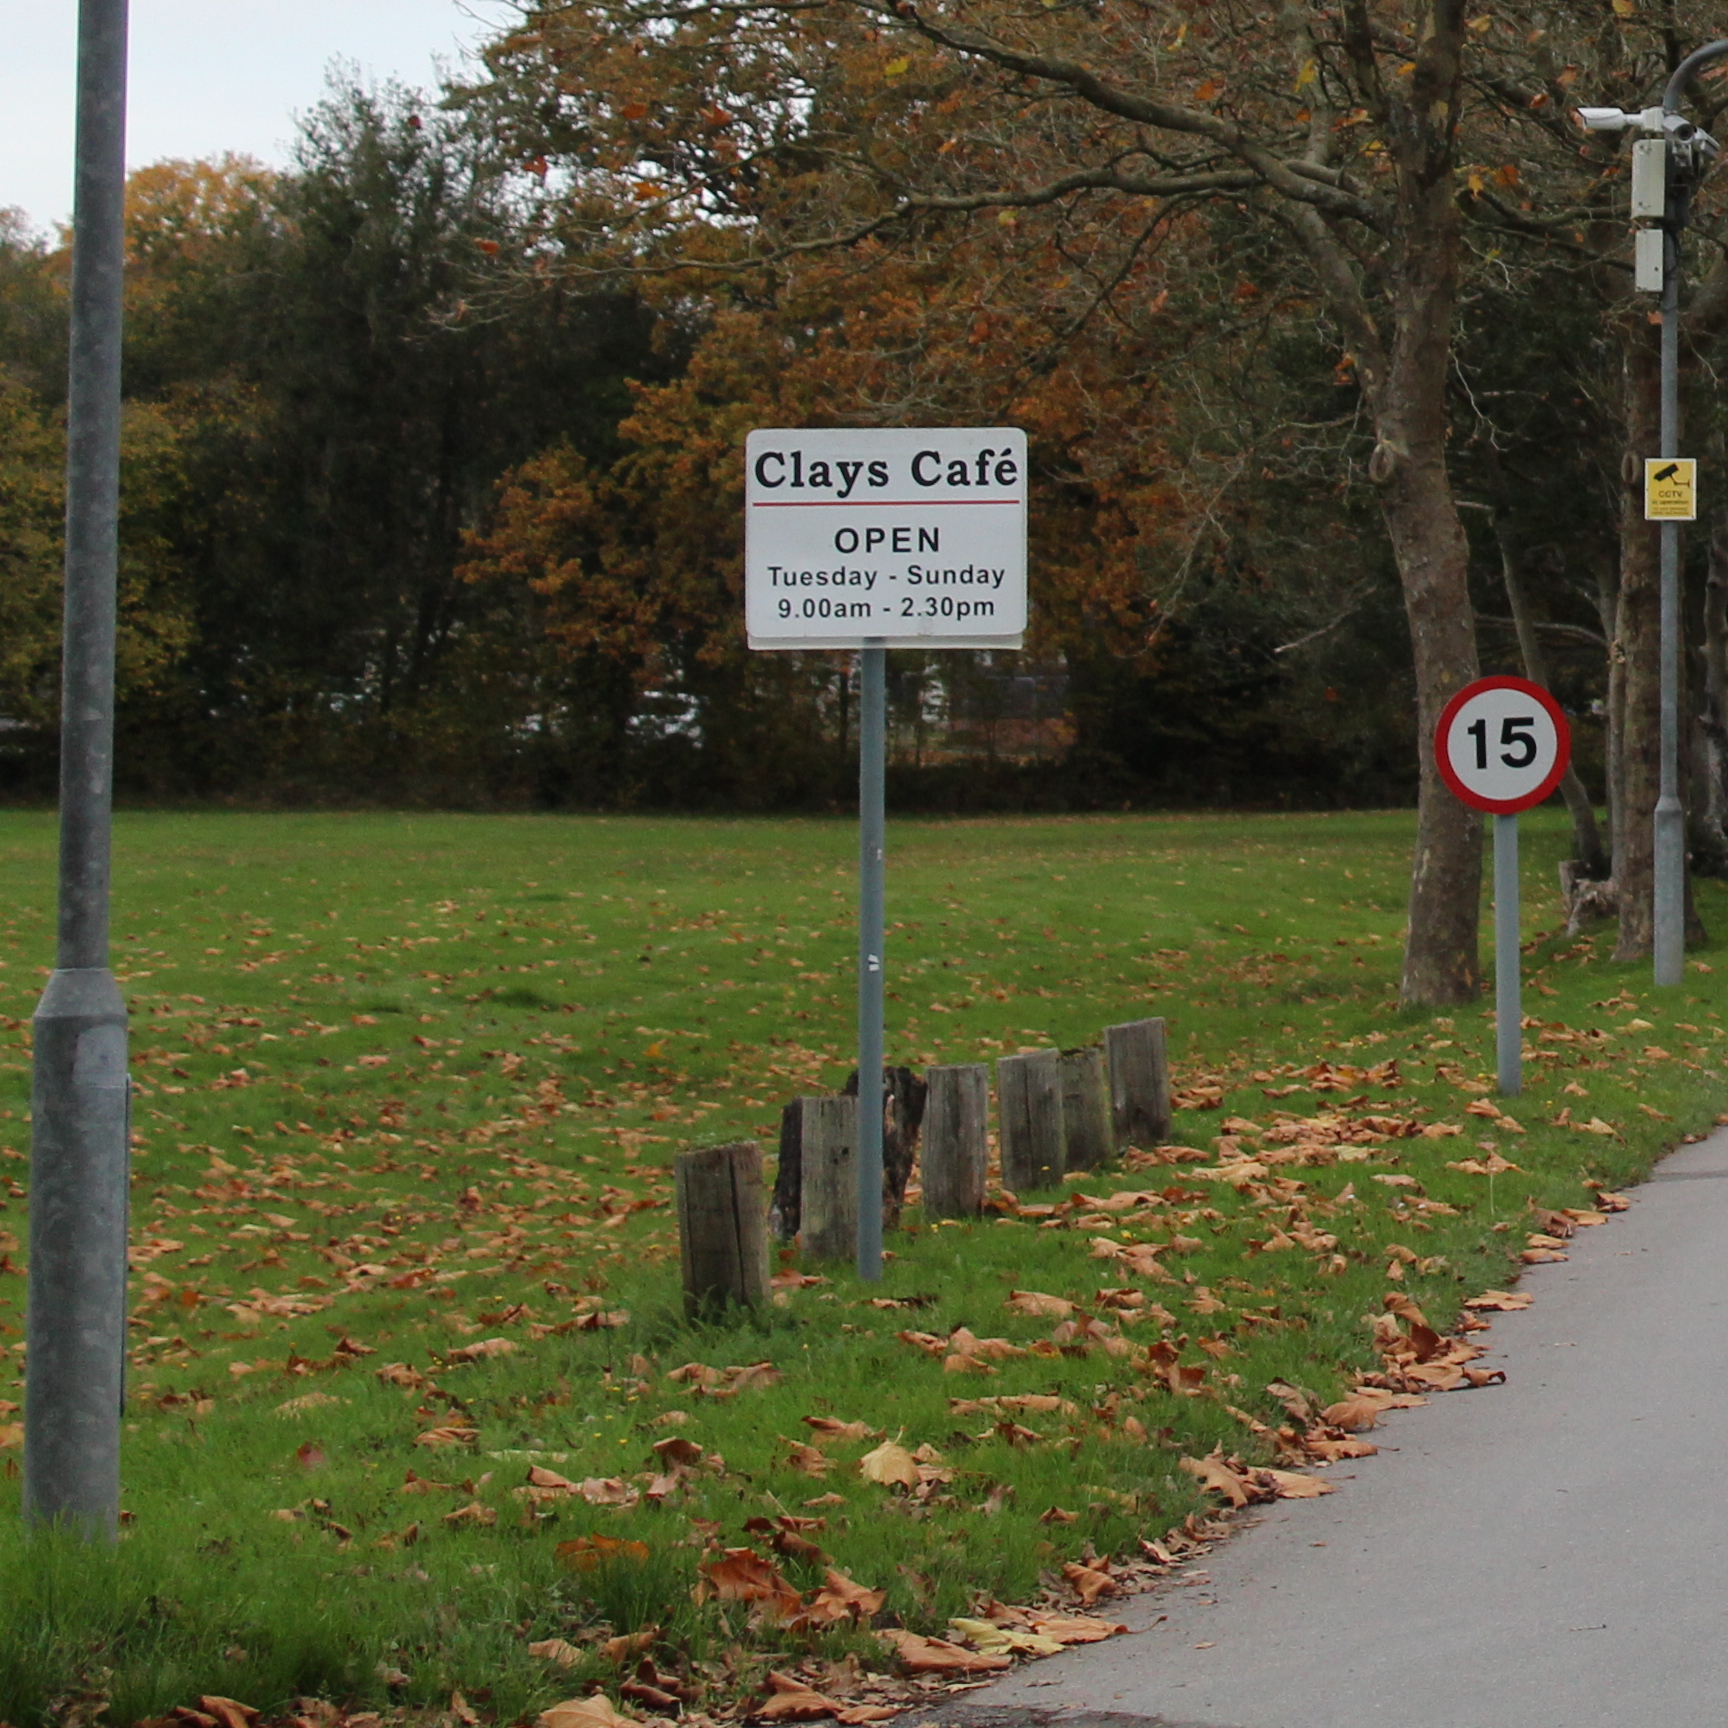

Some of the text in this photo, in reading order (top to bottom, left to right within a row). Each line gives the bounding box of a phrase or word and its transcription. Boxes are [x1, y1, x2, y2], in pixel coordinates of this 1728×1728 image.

[755, 447, 1018, 499] Clays Café
[1658, 490, 1683, 498] CCTV
[834, 527, 940, 554] OPEN
[767, 566, 878, 591] Tuesday
[907, 564, 1006, 589] Sunday
[778, 598, 872, 619] 9.00am
[901, 596, 995, 621] 2.30pm
[1467, 716, 1537, 770] 15
